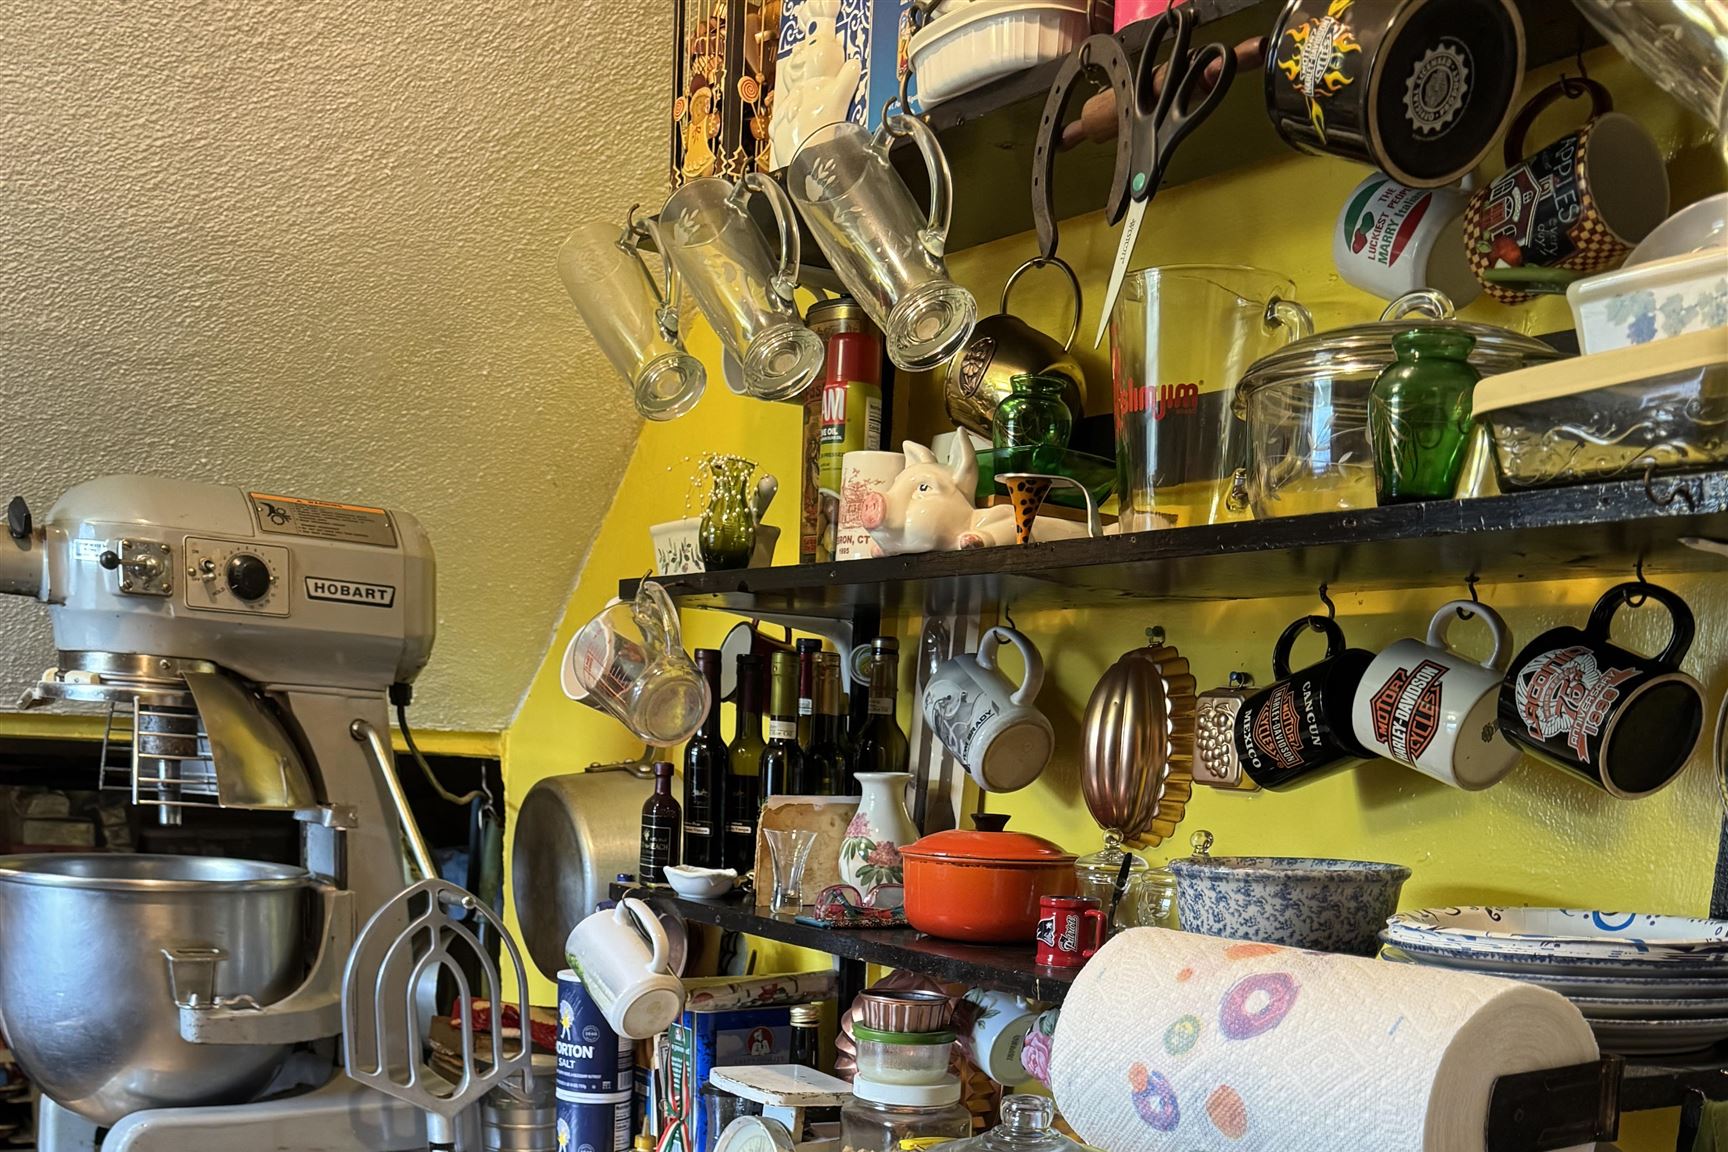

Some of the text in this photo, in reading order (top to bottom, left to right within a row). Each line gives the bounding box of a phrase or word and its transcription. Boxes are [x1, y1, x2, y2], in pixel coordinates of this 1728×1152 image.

[1377, 187, 1397, 202] THE
[1552, 136, 1581, 224] APPLES
[1367, 186, 1413, 261] LUCKIEST PEOP
[1377, 219, 1400, 265] MARRY
[821, 387, 845, 422] AM
[857, 535, 871, 545] CT
[313, 581, 389, 601] HOBART
[966, 709, 993, 742] BRADY
[1271, 691, 1296, 763] HARLEY-DAVIDSON
[1282, 700, 1300, 748] MOTOR
[1302, 680, 1322, 747] CANCUN
[1376, 679, 1404, 735] MOTOR
[1391, 665, 1440, 762] HARLEY-DAVIDSON
[1409, 690, 1437, 750] CYCLES
[1570, 671, 1617, 745] ANNIVERSARY
[1243, 708, 1262, 769] MEXICO
[1259, 708, 1277, 755] CYCLES
[556, 1041, 595, 1059] ORTON
[558, 1057, 576, 1070] SALT
